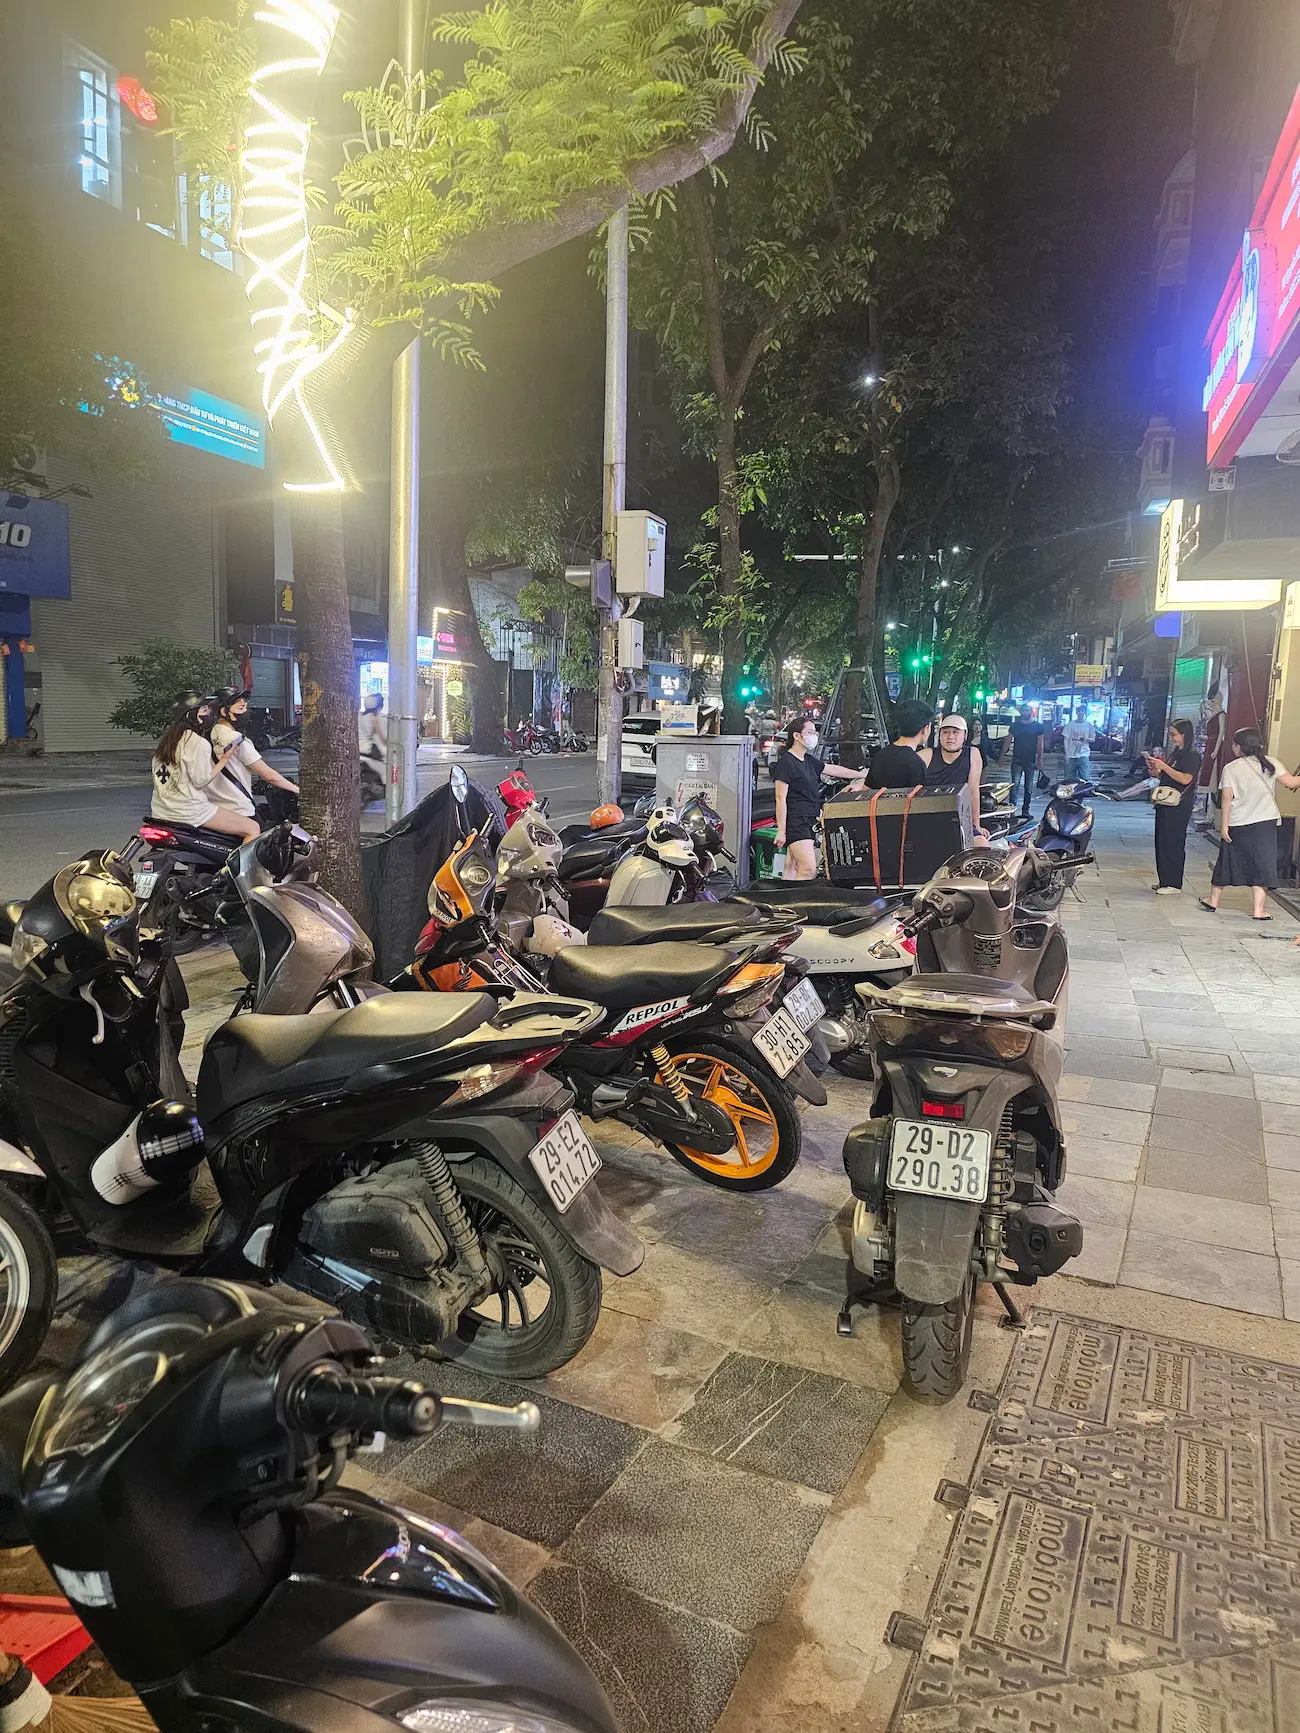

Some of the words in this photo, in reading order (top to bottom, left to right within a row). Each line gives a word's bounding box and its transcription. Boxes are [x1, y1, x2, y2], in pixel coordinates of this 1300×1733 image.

[626, 1000, 679, 1025] REPSOL
[773, 1032, 805, 1071] 7485
[539, 1120, 580, 1175] 29-E2
[906, 1125, 975, 1162] 29-D2
[550, 1143, 597, 1205] 014.72
[894, 1156, 981, 1196] 290.38
[1069, 1335, 1103, 1412] mobifone
[1019, 1515, 1068, 1643] mobifone
